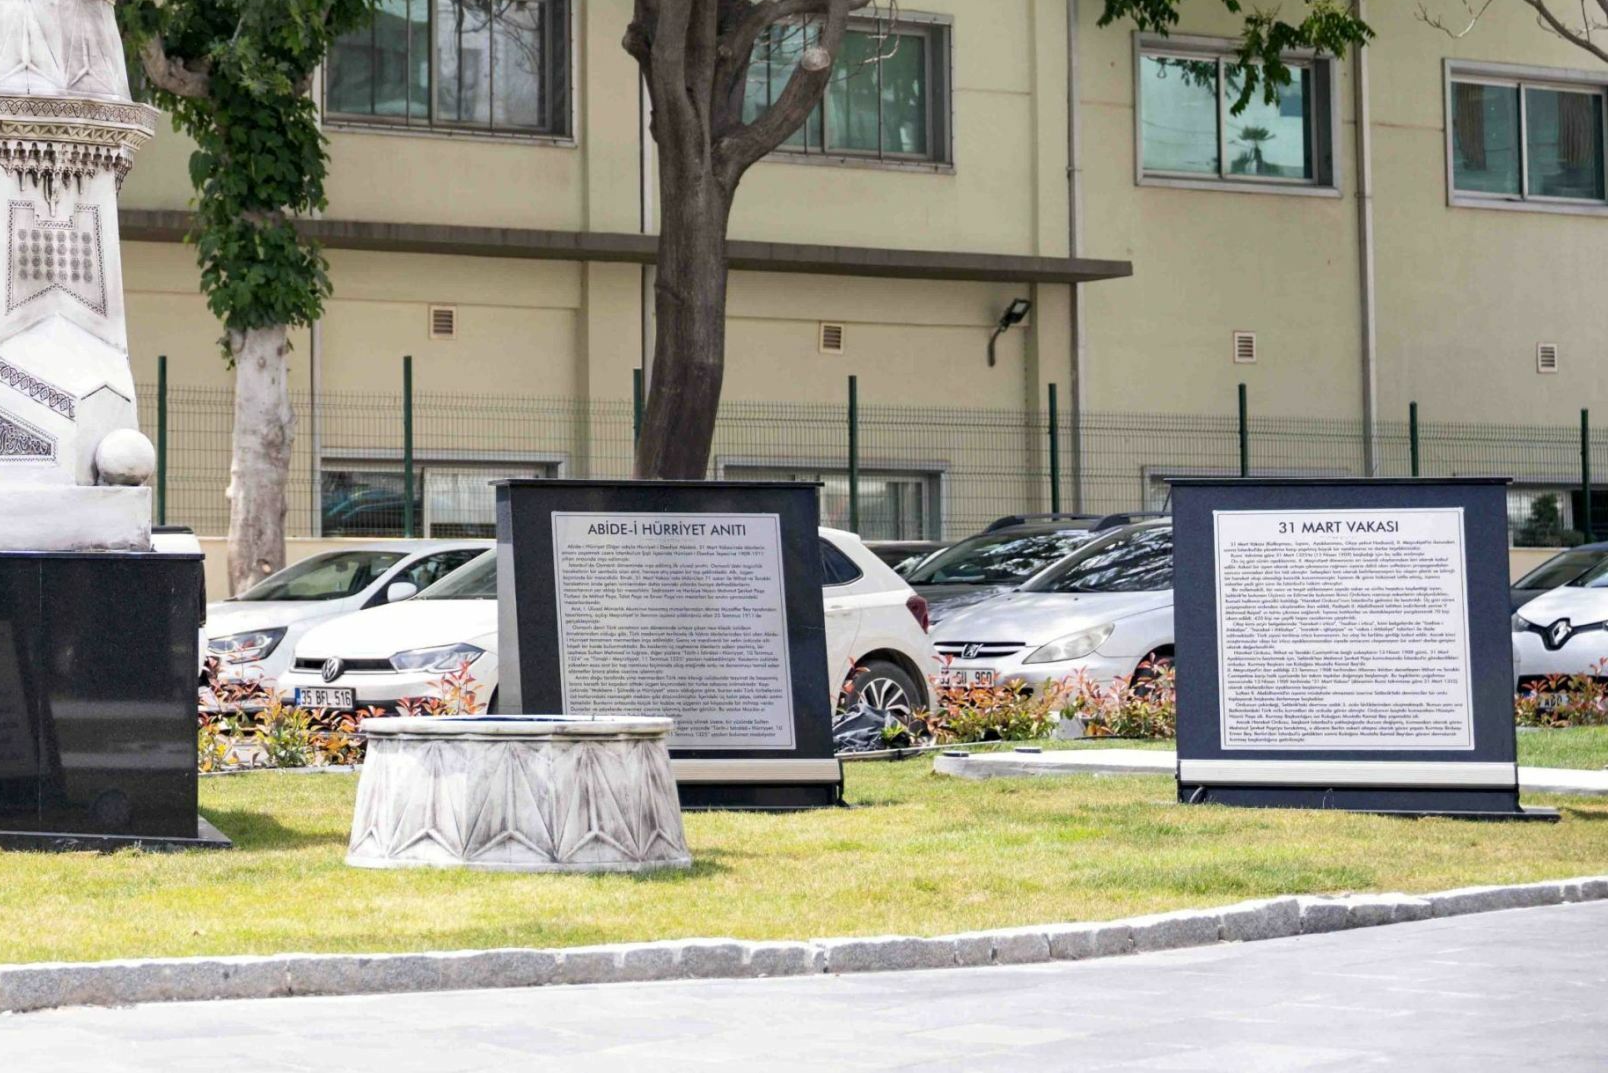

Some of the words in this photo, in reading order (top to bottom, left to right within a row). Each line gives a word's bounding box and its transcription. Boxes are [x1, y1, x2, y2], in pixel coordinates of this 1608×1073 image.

[588, 520, 636, 535] ABİDE-İ
[642, 520, 706, 536] HÜRRİYET
[710, 524, 746, 536] ANITI
[1278, 521, 1295, 533] 31
[1301, 521, 1342, 533] MART
[1346, 520, 1399, 533] VAKASI
[301, 690, 312, 705] 35
[315, 690, 331, 705] BFL
[334, 691, 351, 706] 516
